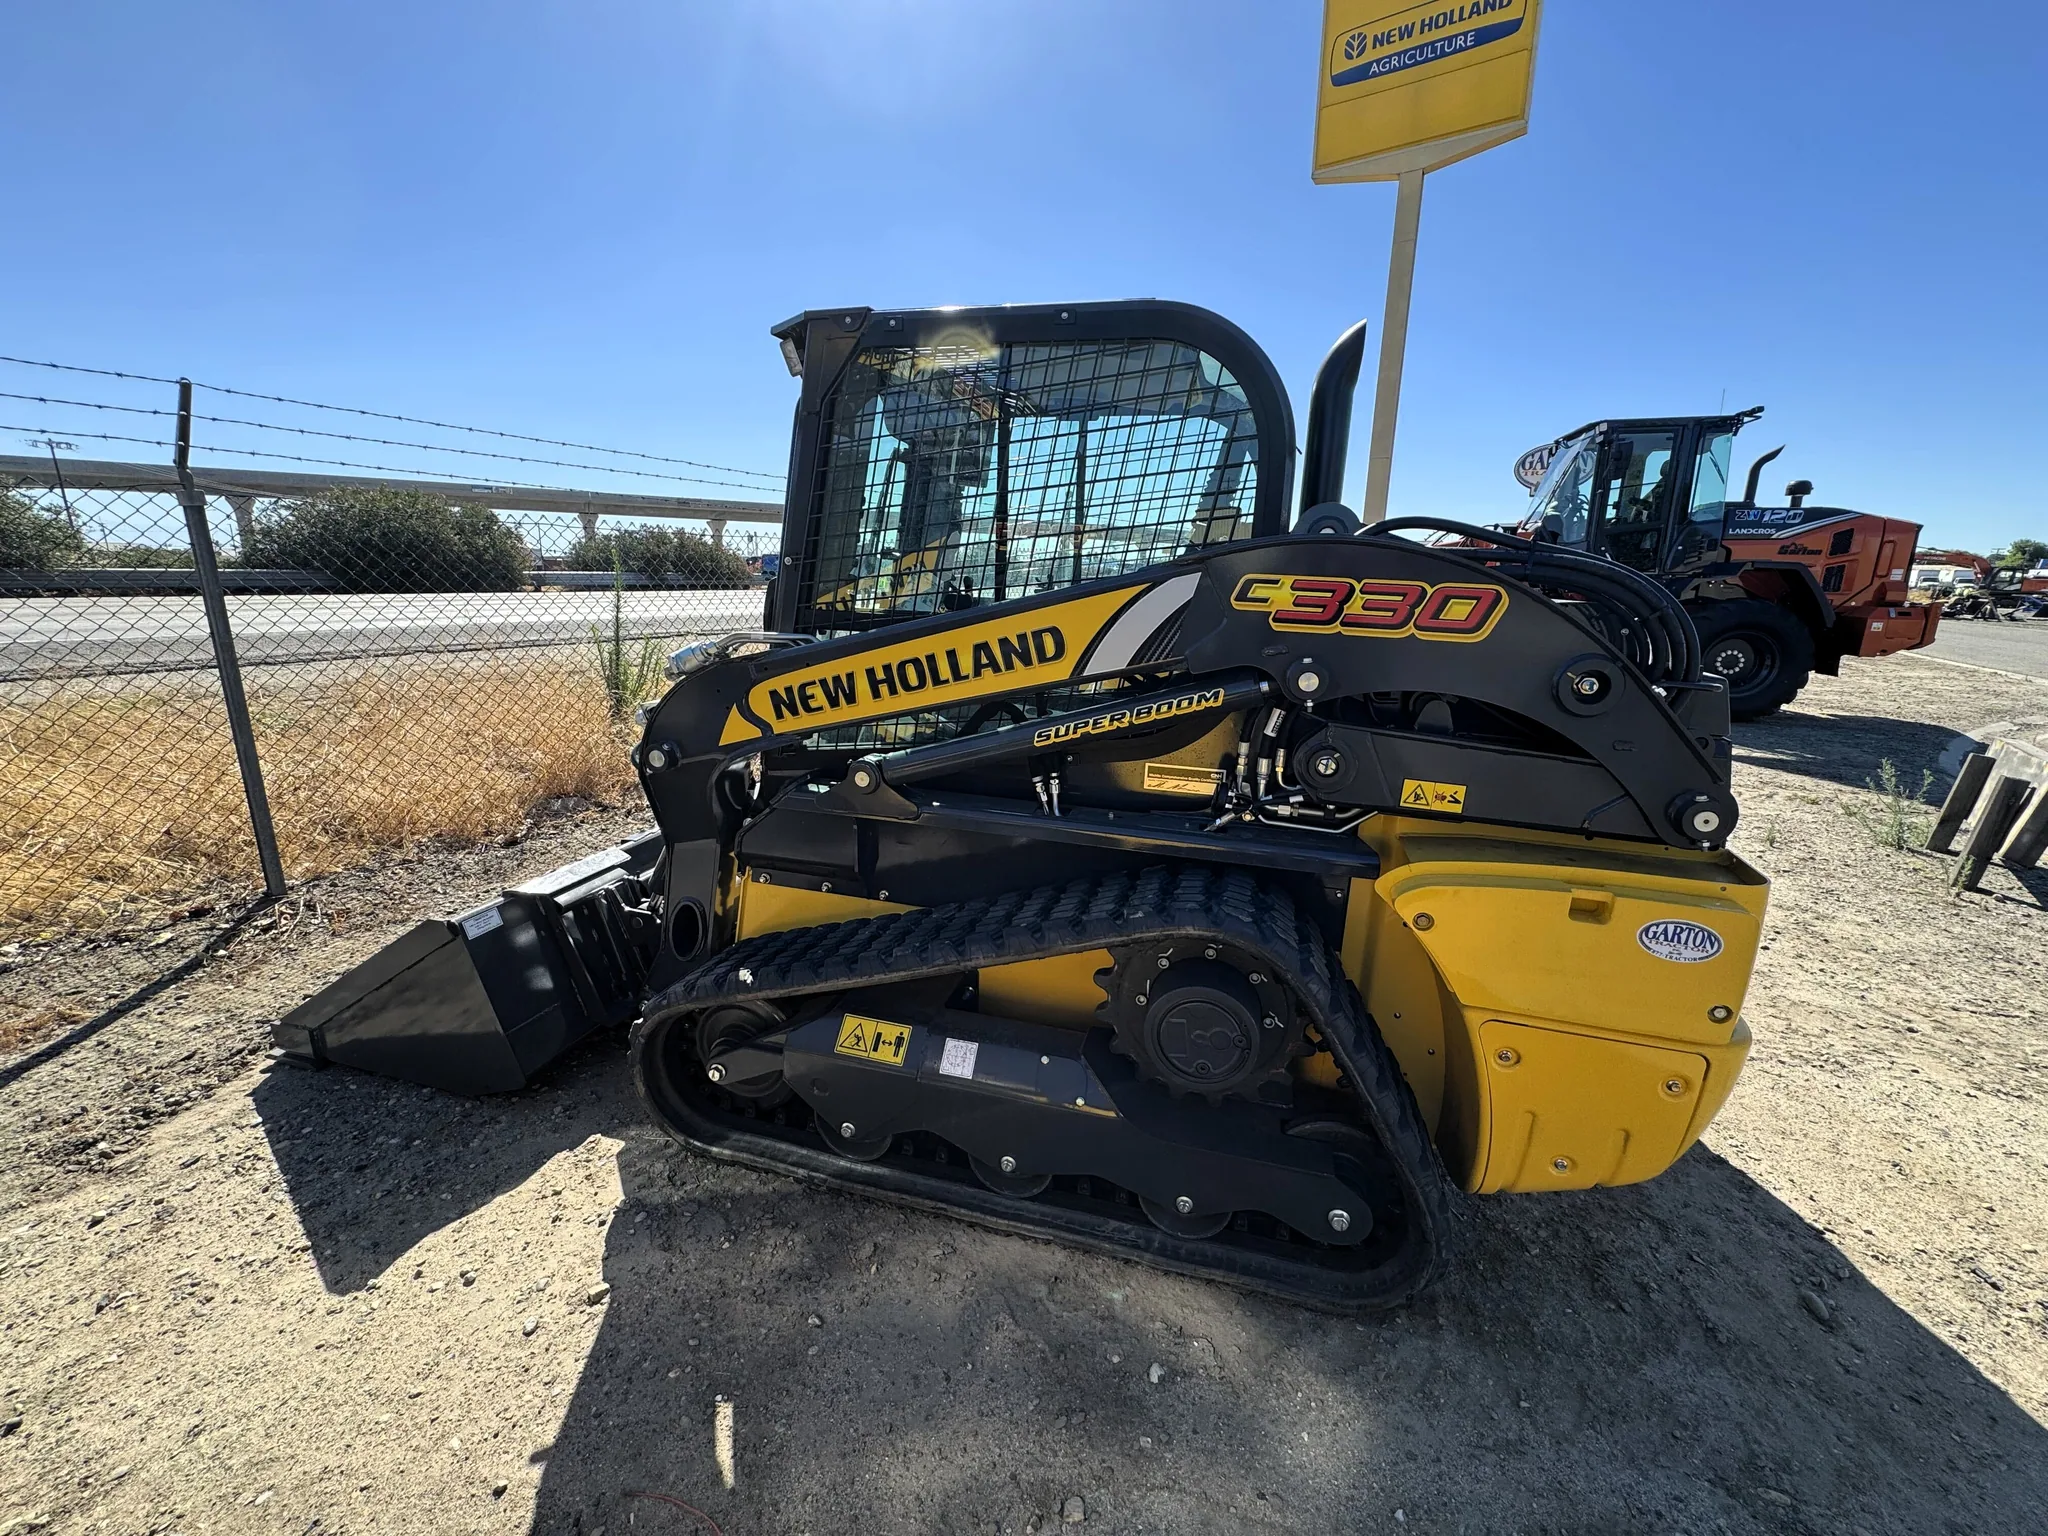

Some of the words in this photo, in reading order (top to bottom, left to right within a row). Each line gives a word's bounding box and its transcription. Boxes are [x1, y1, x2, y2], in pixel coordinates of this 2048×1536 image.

[1372, 21, 1416, 49] NEW
[1419, 0, 1513, 35] HOLLAND
[1369, 31, 1475, 75] AGRICULTURE
[1231, 574, 1509, 643] C330
[768, 671, 858, 722] NEW
[868, 625, 1068, 701] HOLLAND
[1034, 709, 1130, 747] SUPER
[1132, 688, 1225, 725] BOOM
[1644, 923, 1718, 951] GARTON
[1647, 938, 1710, 954] TRACTOR
